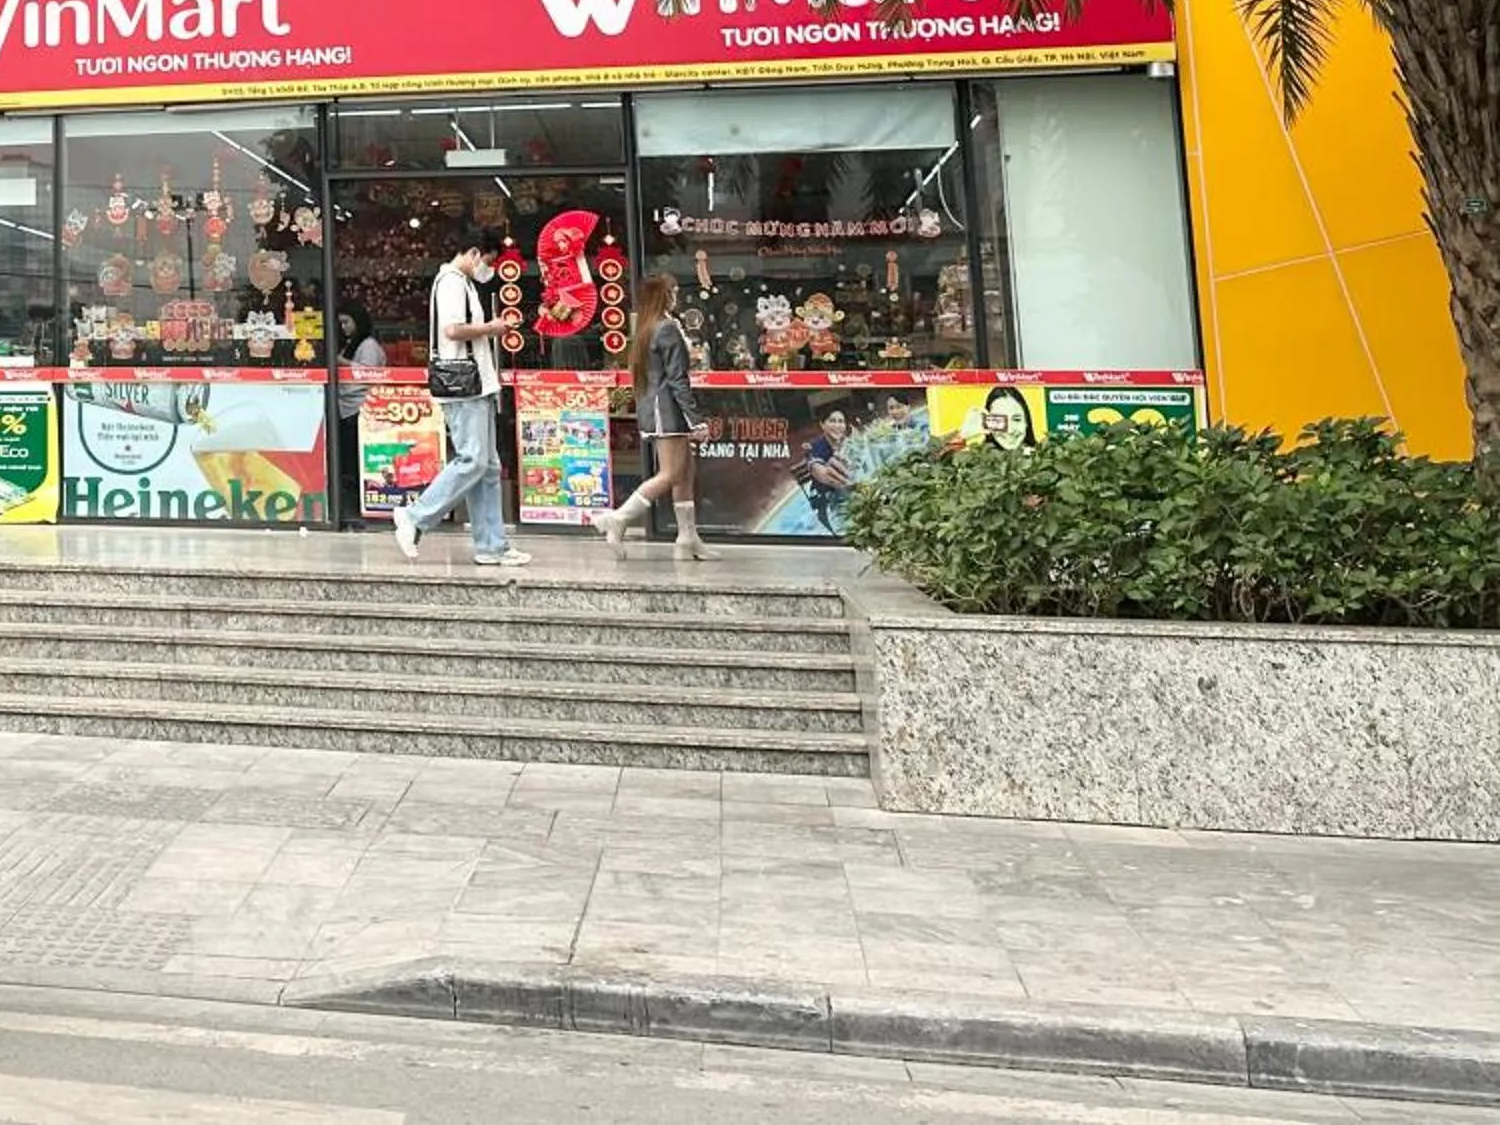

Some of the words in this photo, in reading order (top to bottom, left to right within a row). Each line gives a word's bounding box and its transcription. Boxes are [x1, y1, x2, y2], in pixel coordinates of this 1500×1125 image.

[721, 26, 779, 48] TƯƠI
[785, 22, 860, 45] NGON
[75, 57, 123, 76] TƯƠI
[127, 53, 189, 74] NGON
[192, 49, 282, 72] THƯỢNG
[285, 45, 352, 68] HẠNG!
[699, 442, 735, 459] SANG
[739, 442, 760, 463] TẠI
[762, 438, 791, 459] NHÀ
[62, 476, 328, 523] Heineken
